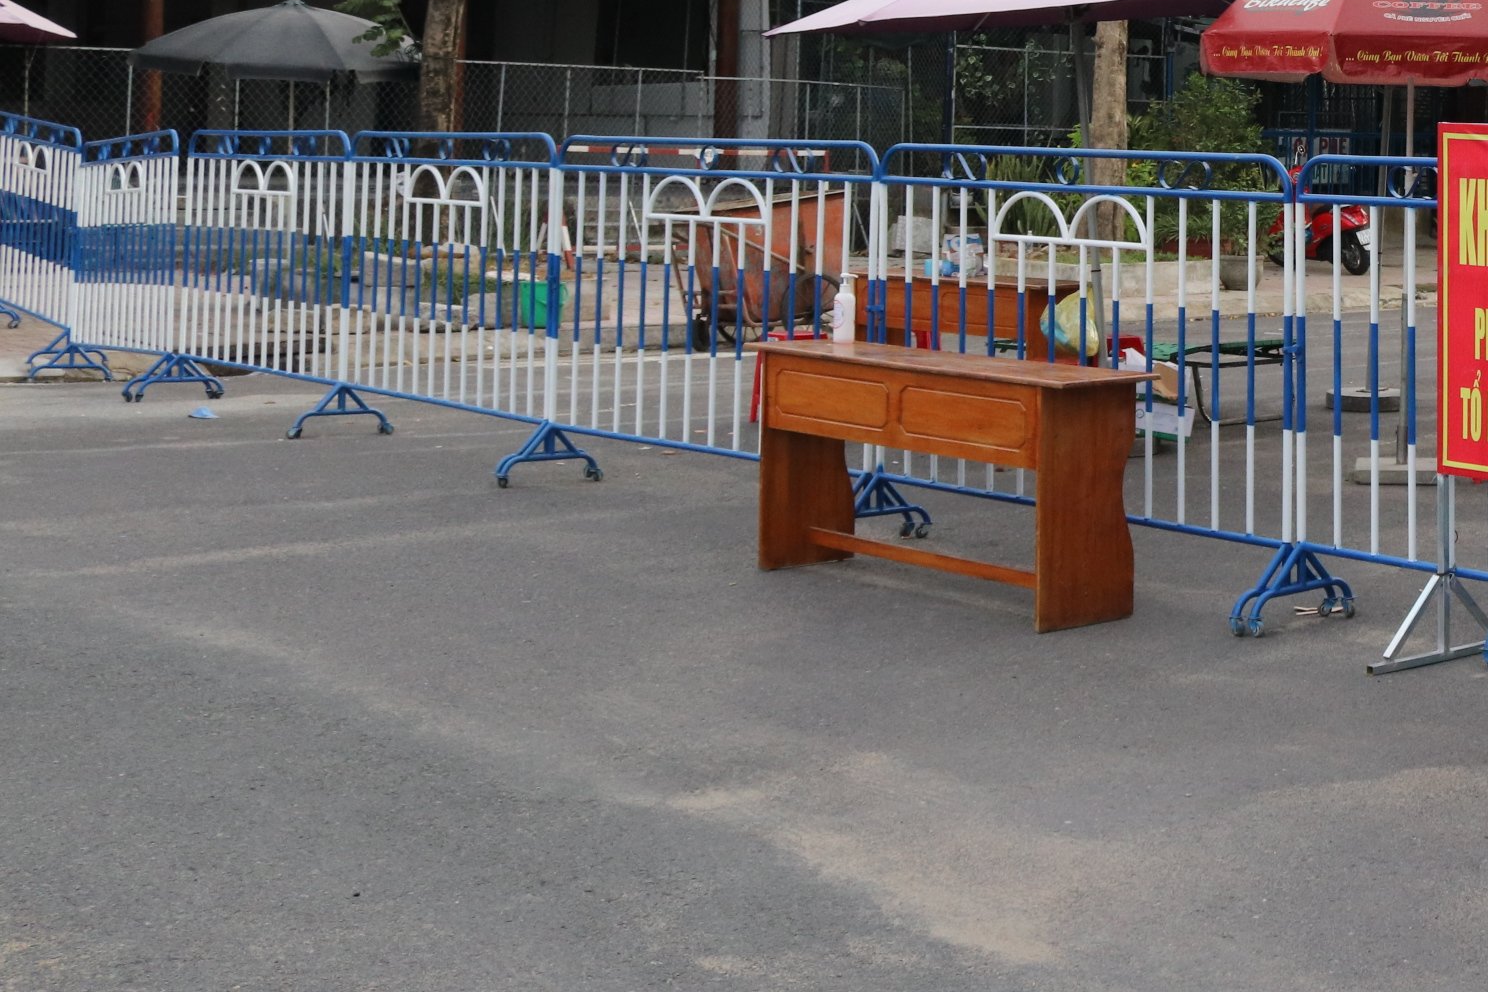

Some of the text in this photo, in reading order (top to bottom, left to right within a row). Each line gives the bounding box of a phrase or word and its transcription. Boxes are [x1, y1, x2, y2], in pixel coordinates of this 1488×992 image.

[1357, 50, 1380, 64] Cùng
[1383, 50, 1401, 64] Bạn
[1452, 51, 1481, 64] Thành
[1460, 369, 1482, 442] TỔ
